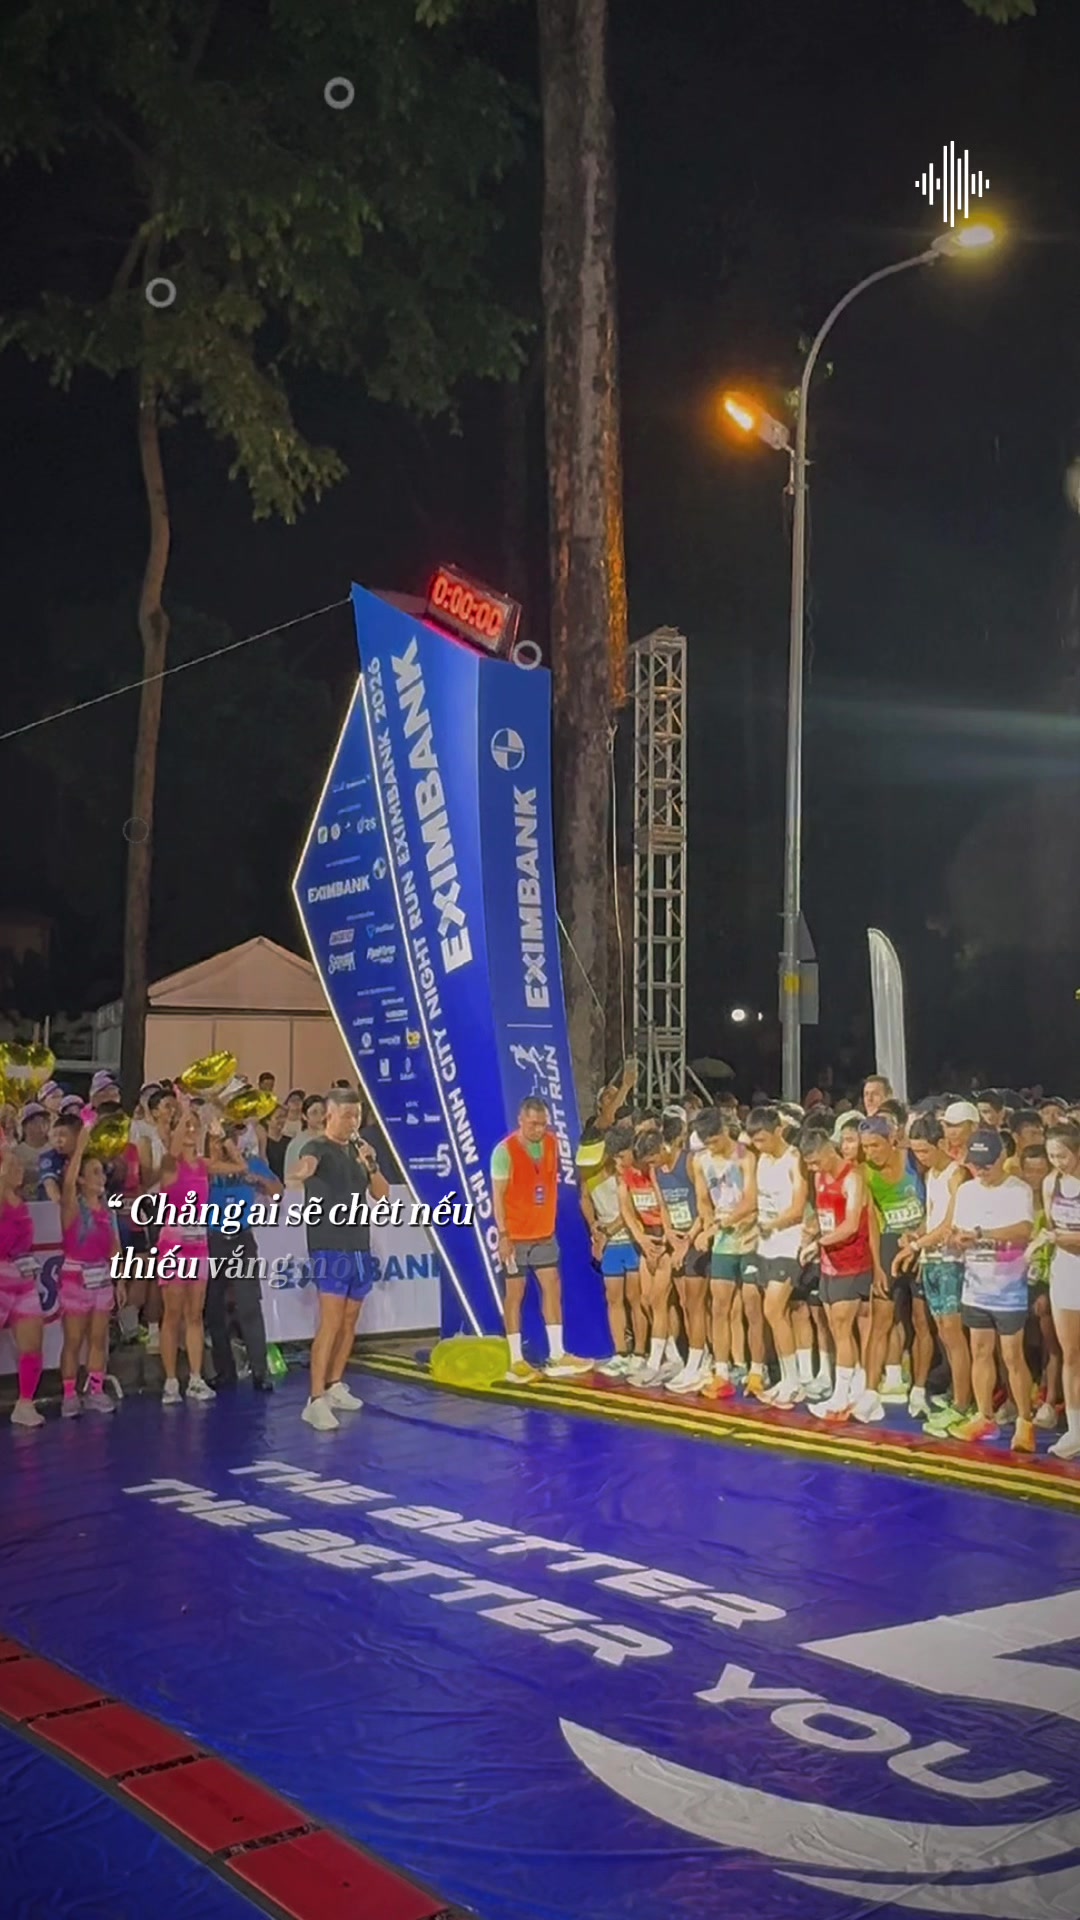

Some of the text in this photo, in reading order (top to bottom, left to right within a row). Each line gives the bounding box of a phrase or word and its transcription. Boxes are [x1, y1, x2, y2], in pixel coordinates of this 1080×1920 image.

[432, 575, 504, 637] 0:00:00
[368, 656, 387, 723] 2026
[378, 727, 410, 867] EXIMBANK
[391, 634, 473, 974] EXIMBANK
[308, 874, 370, 904] EXIMBANK
[402, 870, 423, 930] RUN
[513, 784, 550, 1008] EXIMBANK
[413, 937, 442, 1020] NIGHT
[432, 1028, 457, 1082] CITY
[448, 1087, 479, 1165] MINH
[544, 1045, 577, 1186] NIGHT RUN
[470, 1170, 492, 1219] CHI
[227, 1459, 787, 1629] THE BETTER
[121, 1478, 1053, 1799] THE BETTER YOU
